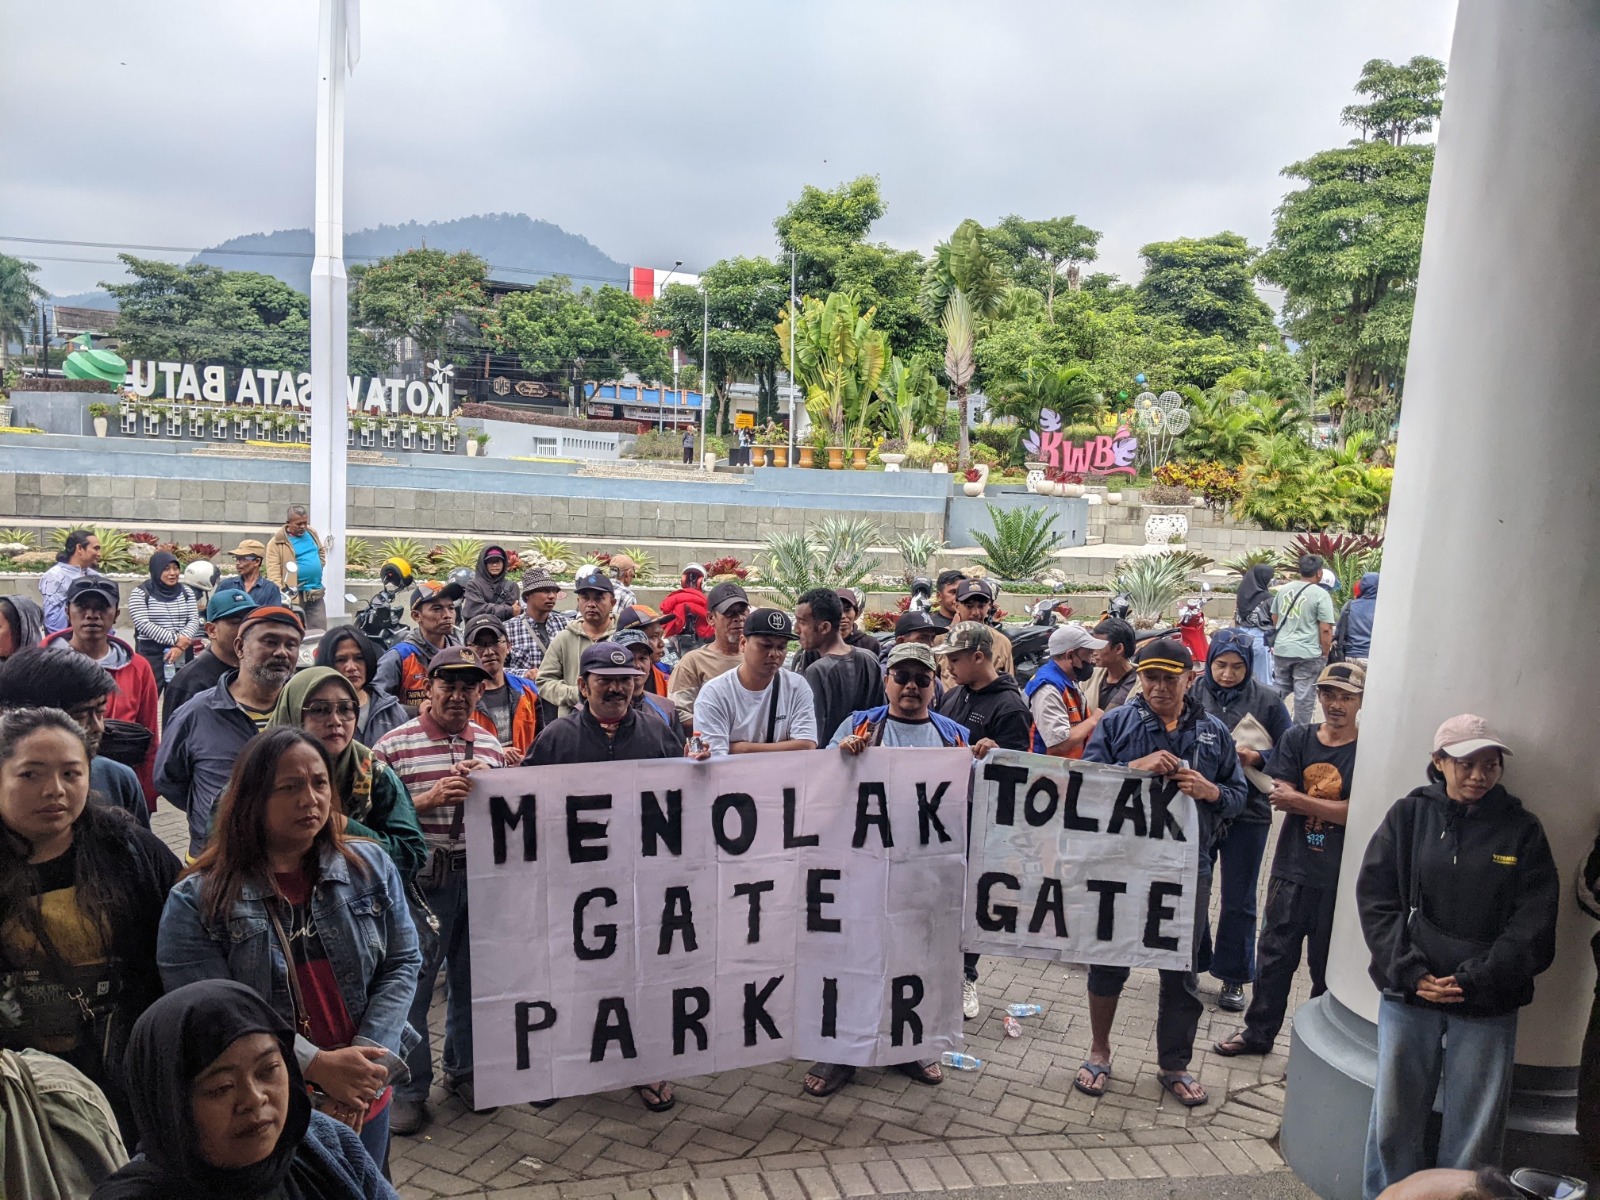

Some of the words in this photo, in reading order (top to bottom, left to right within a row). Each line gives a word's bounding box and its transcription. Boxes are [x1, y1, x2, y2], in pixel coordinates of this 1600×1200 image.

[1039, 431, 1116, 474] KWB
[488, 781, 951, 865] MENOLAK
[983, 763, 1187, 842] TOLAK
[572, 868, 842, 961] GATE
[975, 871, 1183, 952] GATE
[514, 974, 925, 1072] PARKIR
